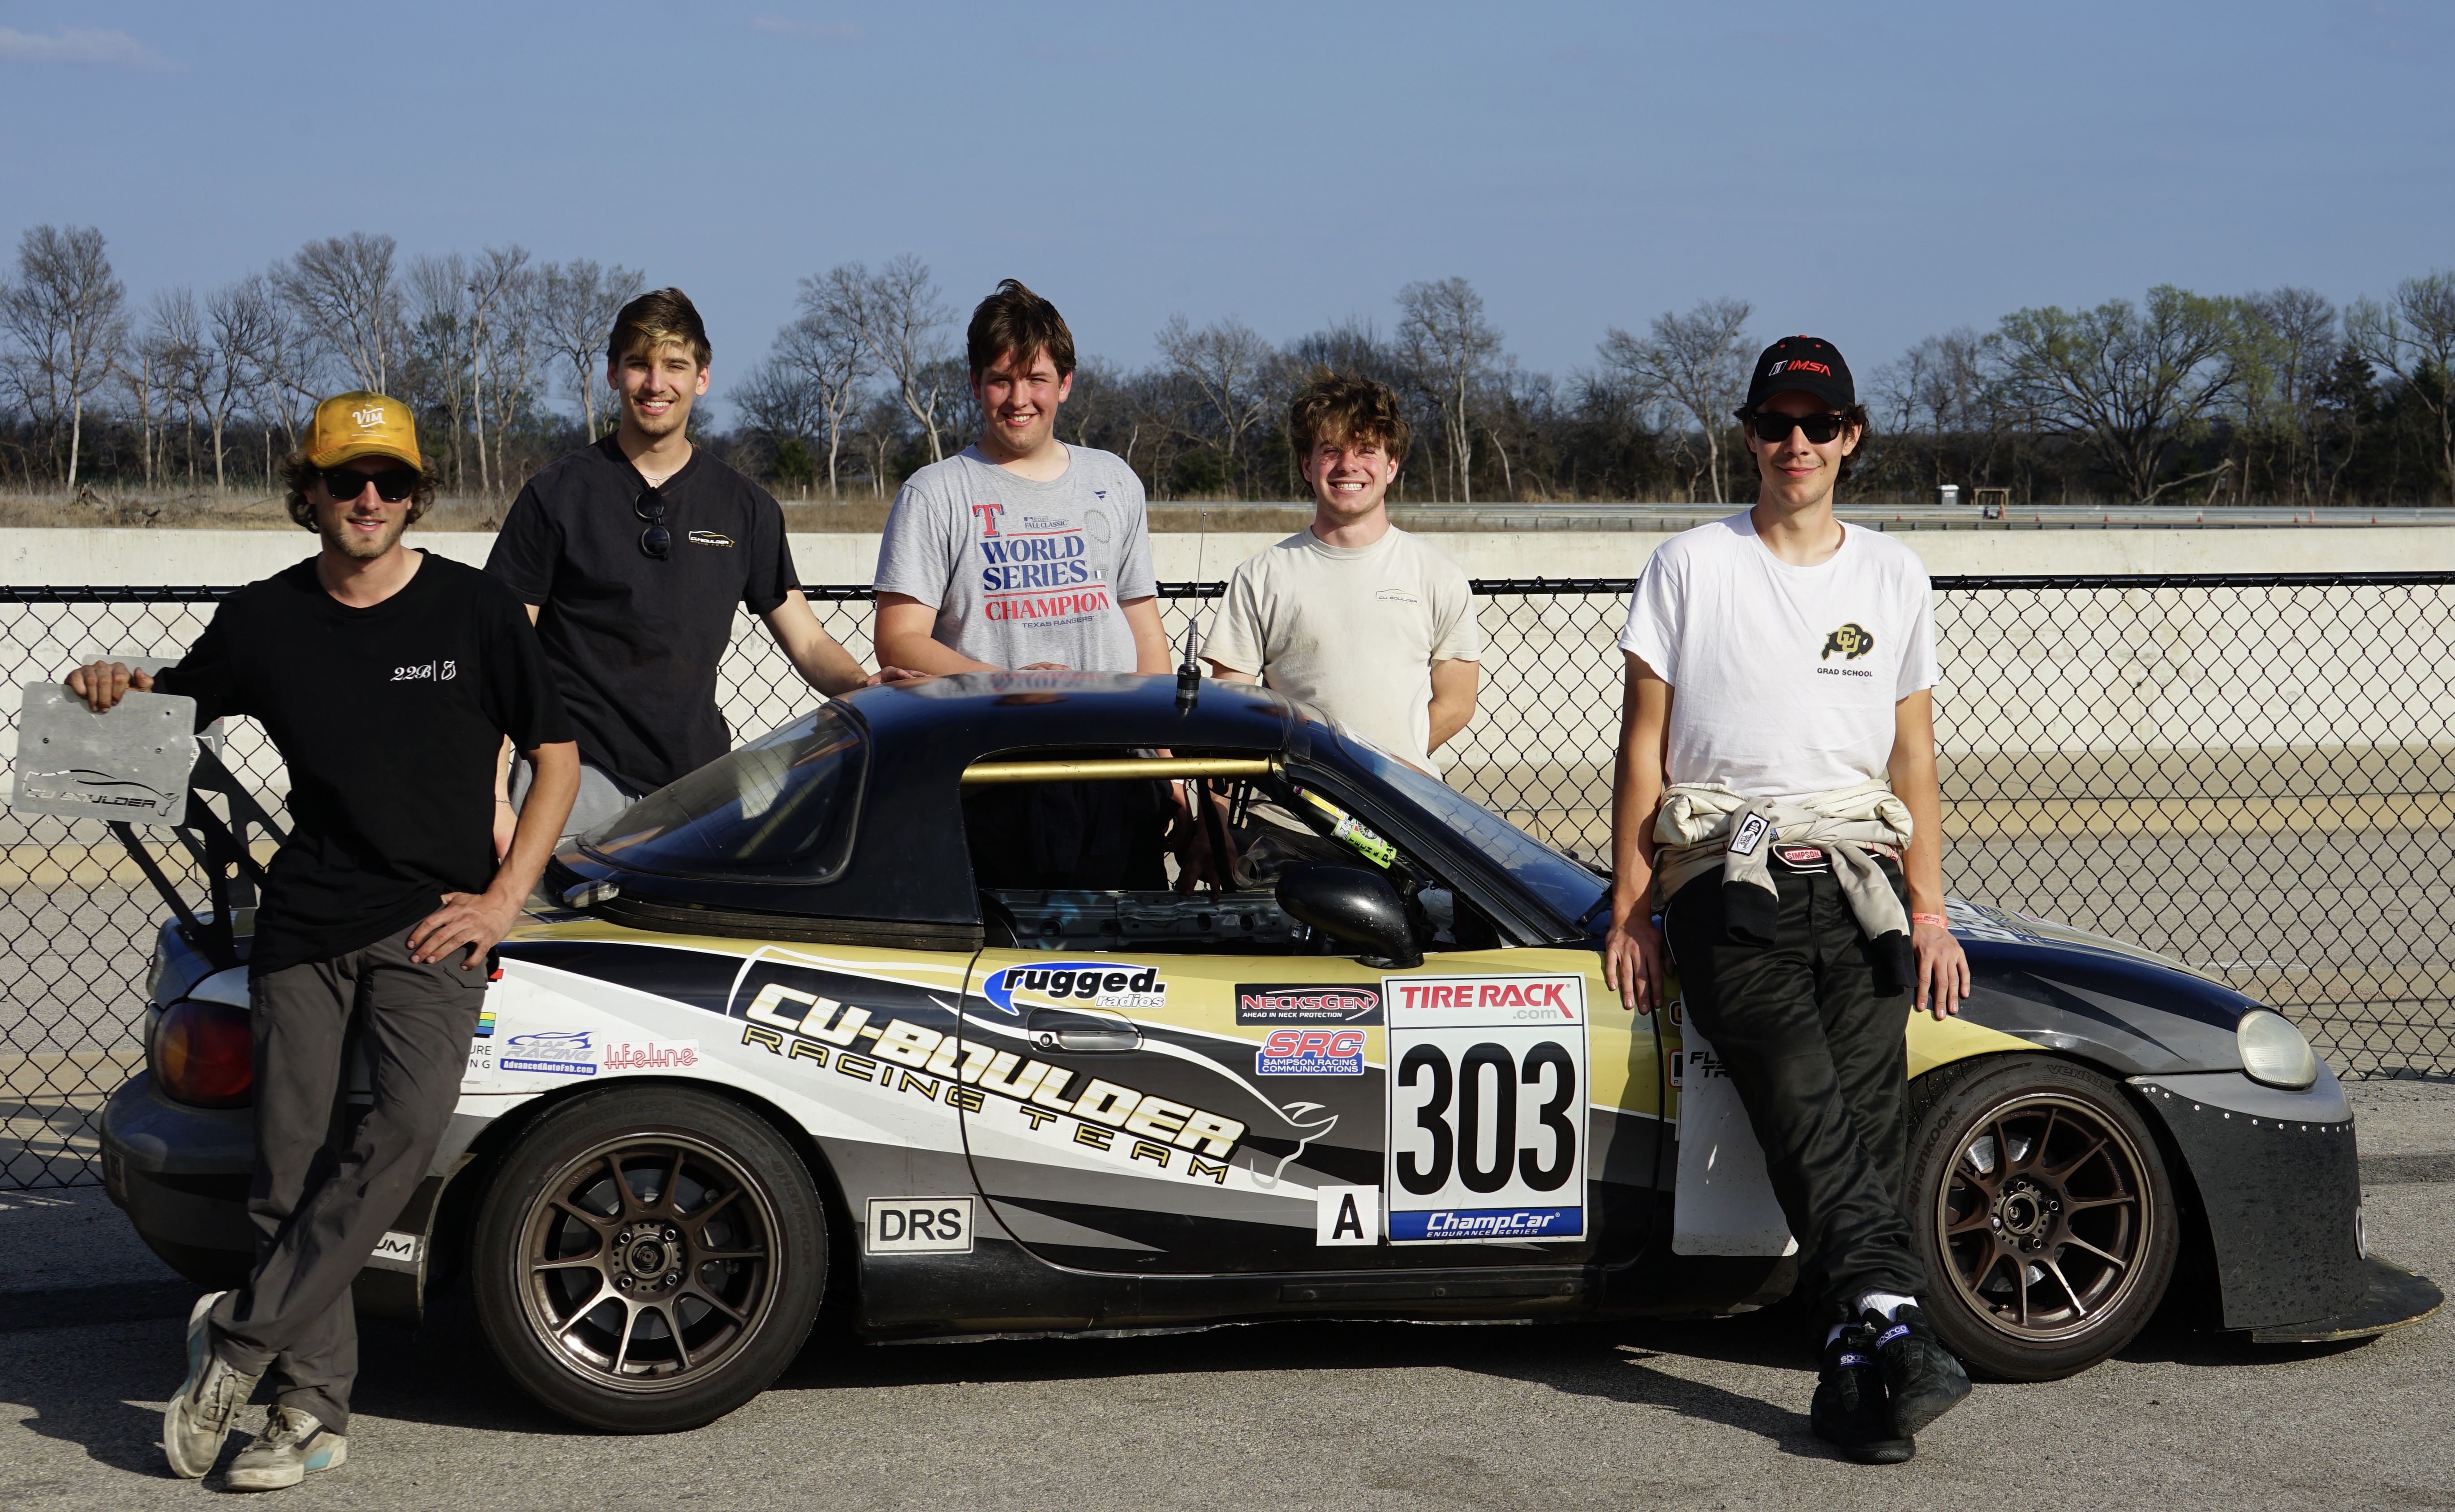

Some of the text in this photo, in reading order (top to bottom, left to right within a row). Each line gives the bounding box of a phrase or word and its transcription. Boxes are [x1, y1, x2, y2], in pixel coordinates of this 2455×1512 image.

[1787, 360, 1831, 377] IMSA
[979, 536, 1084, 564] WORLD
[983, 560, 1088, 591] SERIES
[985, 592, 1109, 621] CHAMPION
[1053, 616, 1093, 626] RANGERS
[1837, 627, 1861, 653] CU
[1787, 851, 1820, 859] SIMPSON
[1096, 994, 1165, 1008] radios
[1400, 984, 1574, 1018] TIRE RACK
[1513, 1009, 1557, 1019] .com
[505, 1046, 595, 1061] RACING
[528, 1040, 568, 1048] AAF
[1264, 1030, 1365, 1058] SRC
[503, 1060, 594, 1074] AdvancedAutoFab.com
[1690, 1051, 1721, 1064] FL
[740, 1024, 1230, 1185] RACING TEAM
[1397, 1041, 1576, 1196] 303
[880, 1208, 961, 1241] DRS
[1332, 1193, 1364, 1240] A
[1426, 1212, 1555, 1235] ChampCar
[1426, 1229, 1492, 1237] ENDURANCE
[1875, 1326, 1907, 1348] sparco
[1840, 1354, 1871, 1364] sparc
